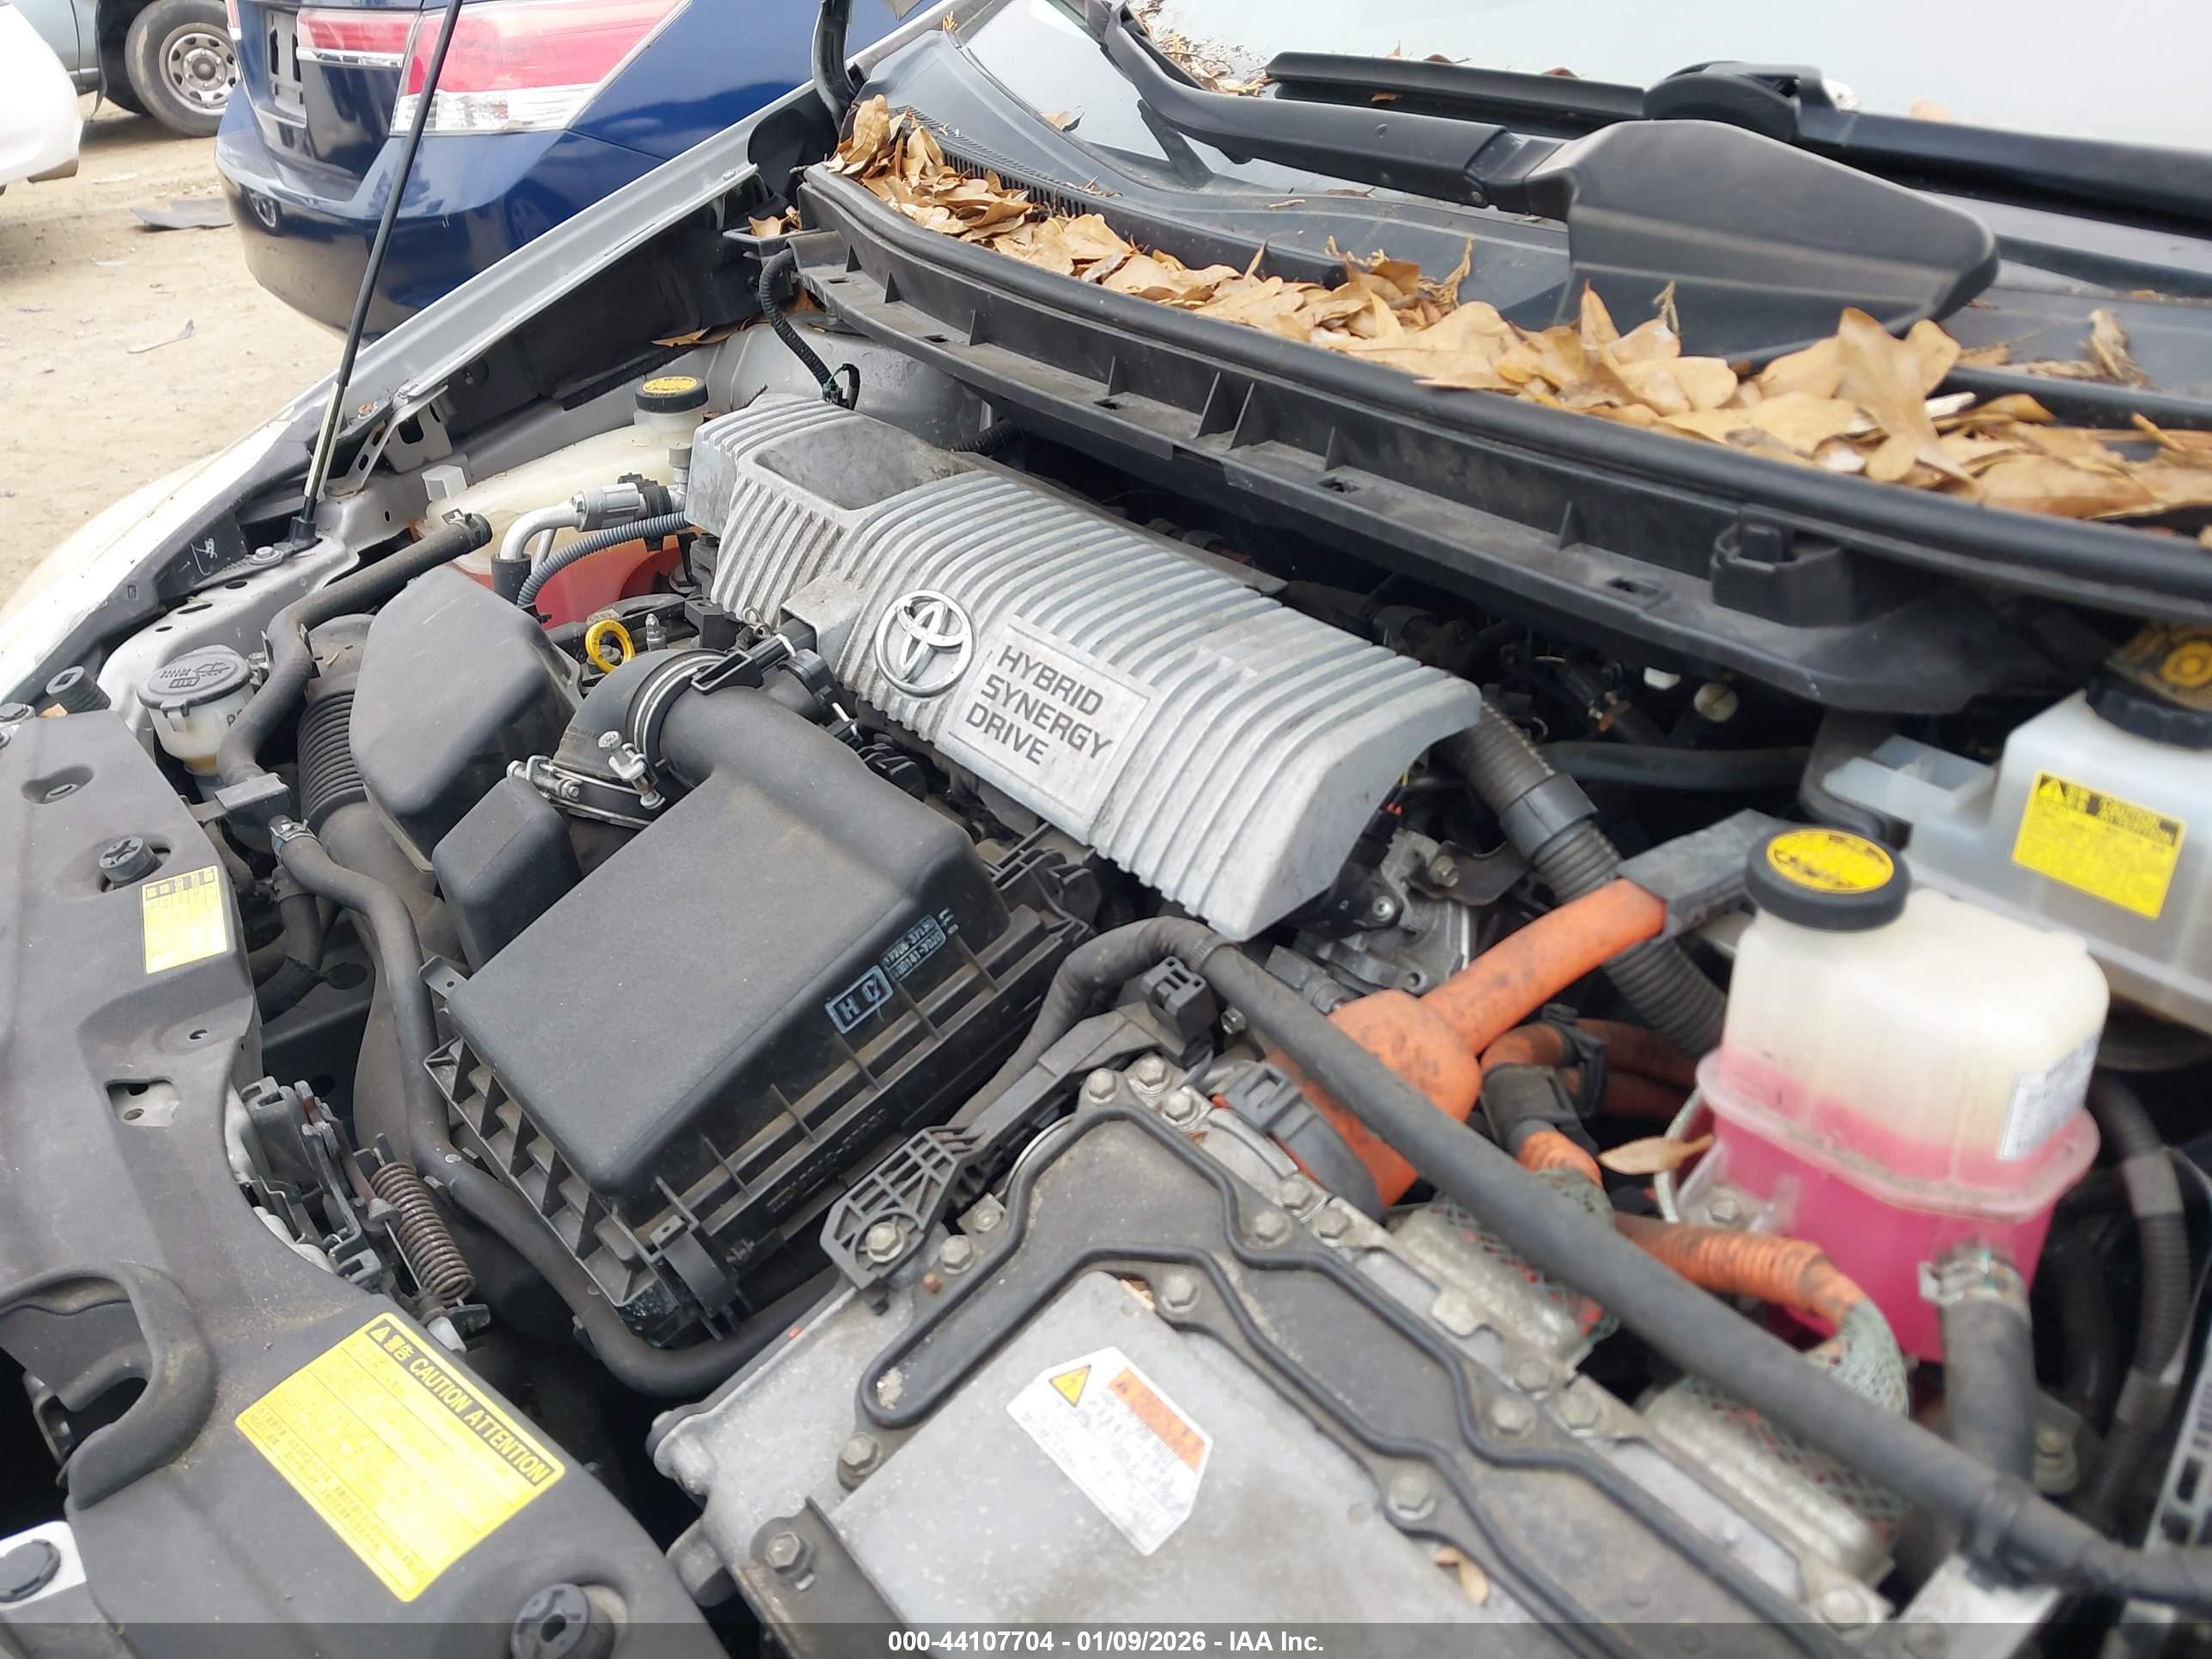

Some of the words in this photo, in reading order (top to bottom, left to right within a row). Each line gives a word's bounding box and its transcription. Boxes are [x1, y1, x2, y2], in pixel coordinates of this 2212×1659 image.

[981, 674, 1113, 759] SYNERGY
[997, 646, 1103, 716] HYBRID
[965, 702, 1048, 765] DRIVE
[410, 1358, 472, 1413] CAUTION
[464, 1409, 550, 1483] ATTENTION
